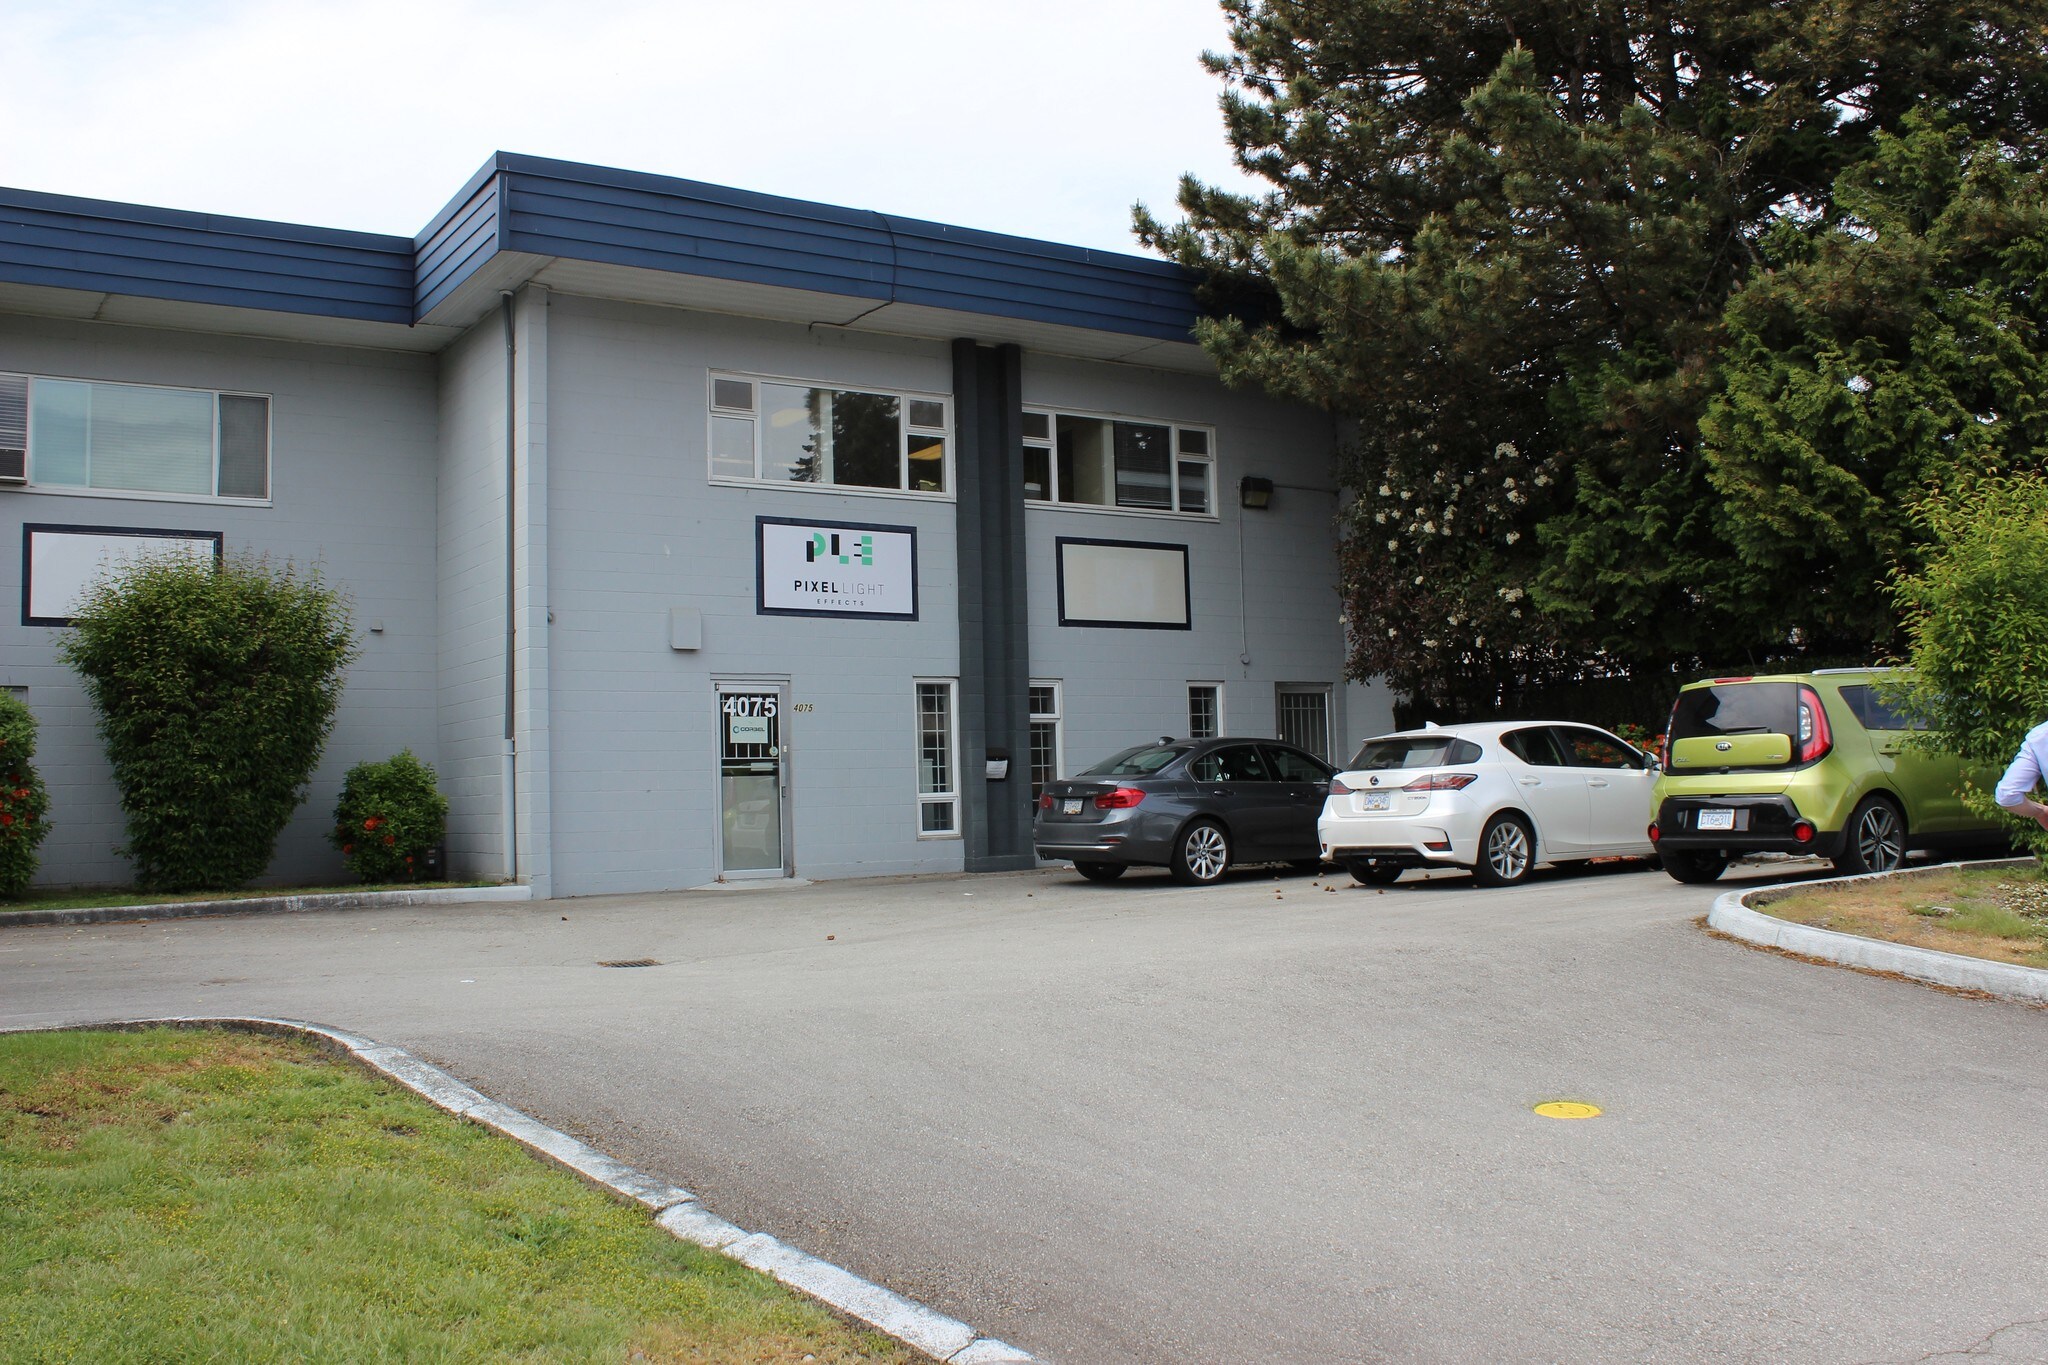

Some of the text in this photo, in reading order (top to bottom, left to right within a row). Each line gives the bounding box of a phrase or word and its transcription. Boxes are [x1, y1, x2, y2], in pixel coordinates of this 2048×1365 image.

[816, 598, 865, 607] EFFECTS
[723, 696, 777, 718] 4075
[793, 703, 814, 713] 4075
